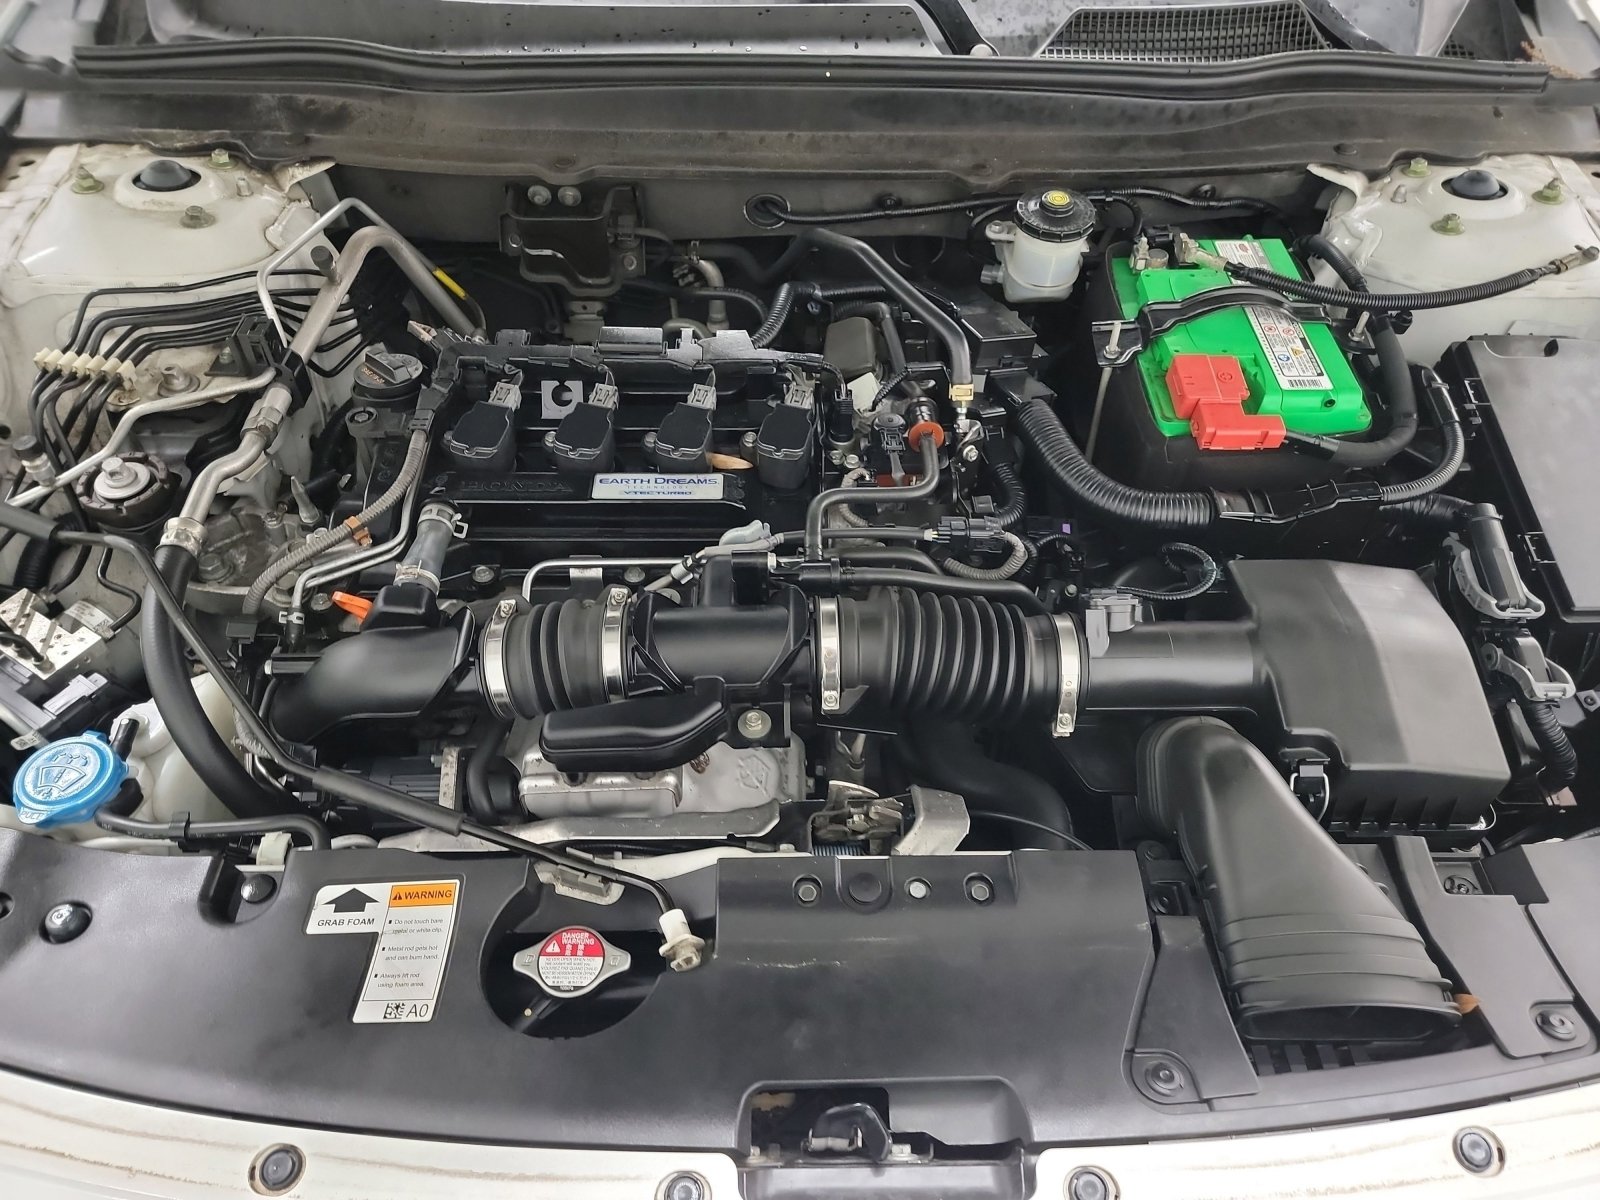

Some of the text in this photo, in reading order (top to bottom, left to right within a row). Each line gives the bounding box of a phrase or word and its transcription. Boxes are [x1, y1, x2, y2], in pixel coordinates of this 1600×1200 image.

[599, 477, 650, 485] EARTH
[404, 889, 453, 900] WARNING
[317, 918, 375, 927] GRAB FOAM
